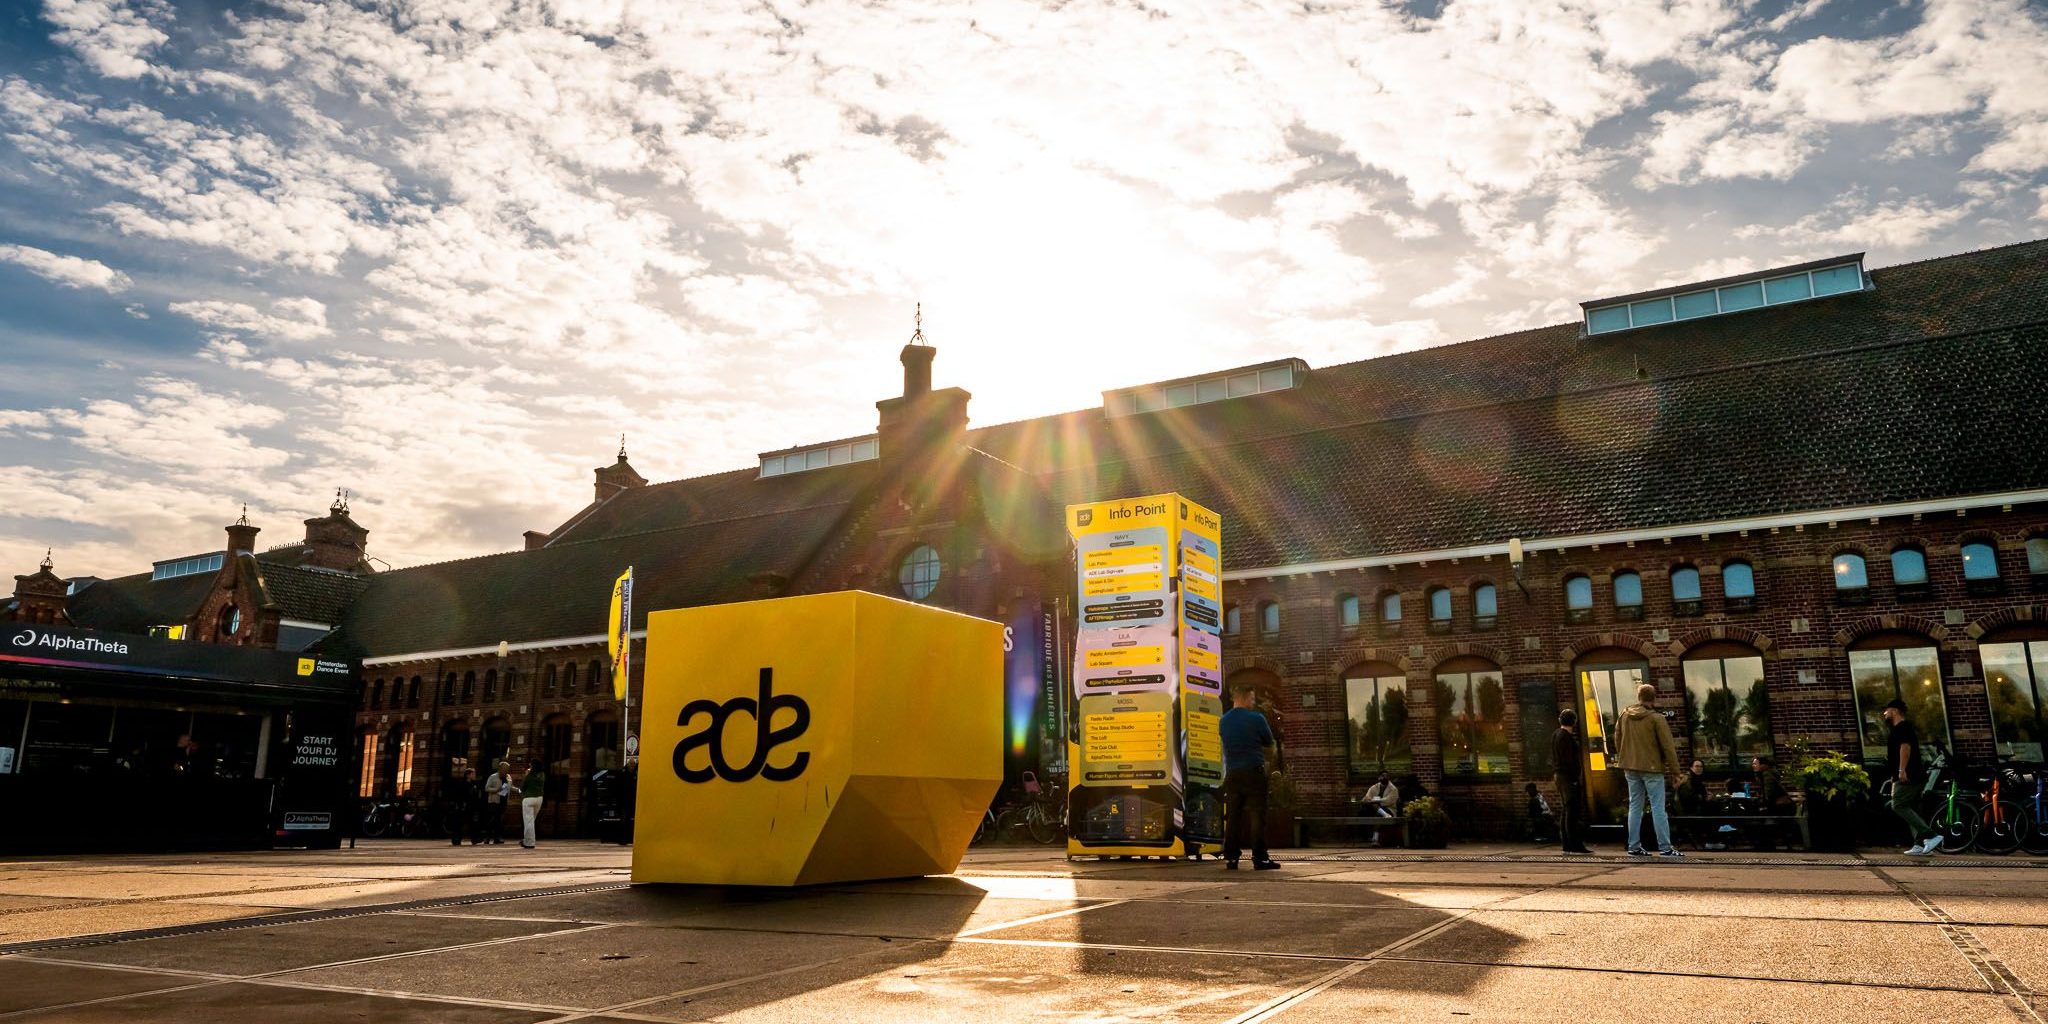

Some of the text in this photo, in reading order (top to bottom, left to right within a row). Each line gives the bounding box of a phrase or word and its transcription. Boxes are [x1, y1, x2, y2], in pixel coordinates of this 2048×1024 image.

[1109, 503, 1166, 519] Info Point
[1044, 613, 1052, 662] FABRIQUE
[38, 633, 128, 654] AlphaTheta
[317, 660, 348, 668] Amsterdam
[672, 667, 811, 783] ade
[303, 736, 333, 745] START
[296, 746, 337, 756] YOUR DJ
[292, 756, 338, 766] JOURNEY
[295, 815, 329, 823] AlphaTheta
